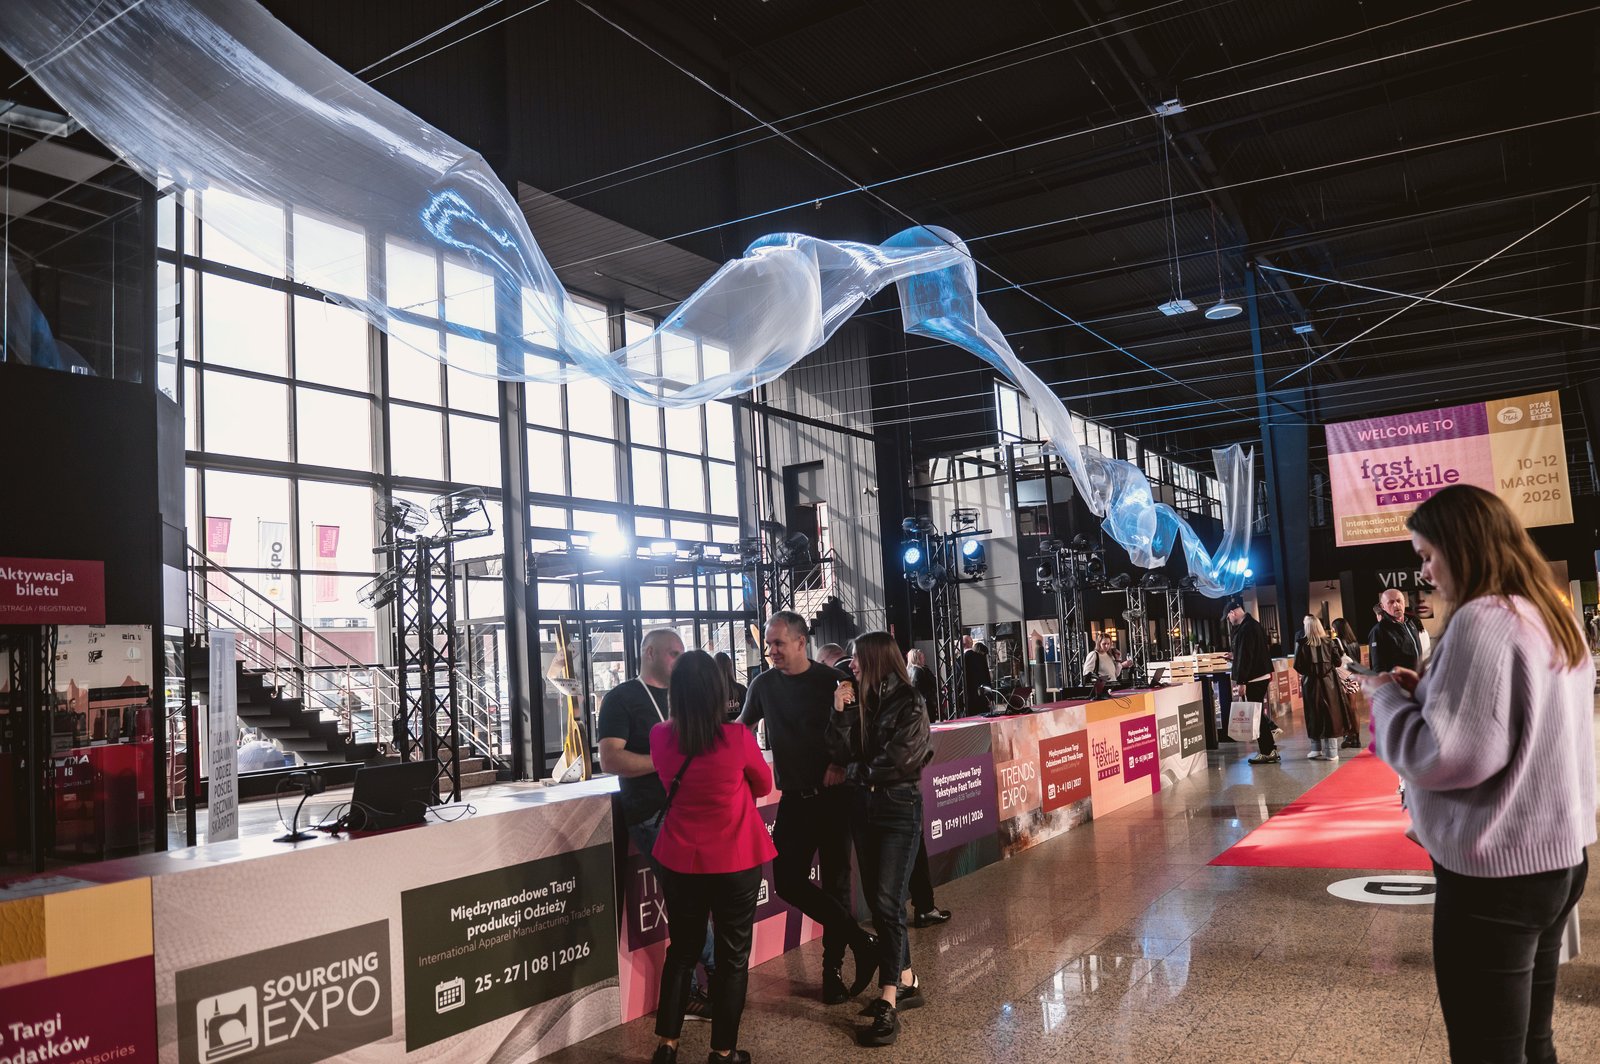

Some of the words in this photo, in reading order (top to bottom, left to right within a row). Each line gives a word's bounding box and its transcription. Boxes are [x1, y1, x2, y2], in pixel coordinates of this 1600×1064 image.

[1529, 401, 1551, 410] PTAK
[1530, 408, 1552, 416] EXPO
[1358, 422, 1430, 442] WELCOME
[1433, 419, 1454, 432] TO
[1361, 456, 1414, 479] fast
[1517, 455, 1557, 470] 10-12
[1372, 464, 1460, 491] textile
[1501, 472, 1559, 489] MARCH
[1380, 491, 1432, 503] FABRI
[1522, 489, 1561, 503] 2026
[1346, 515, 1398, 528] International
[1347, 527, 1382, 537] Knitwear
[1383, 525, 1400, 533] and
[0, 567, 74, 584] Aktywacja
[1379, 572, 1407, 588] VIP
[16, 583, 58, 597] biletu
[38, 605, 87, 613] REGISTRATION
[1092, 738, 1107, 757] fast
[1166, 731, 1178, 748] EXPO
[1096, 745, 1119, 768] textile
[932, 770, 971, 787] Międzynarodowe
[970, 766, 982, 777] Targi
[1001, 761, 1035, 788] TRENDS
[935, 785, 957, 798] Tekstylne
[958, 782, 967, 792] Fast
[967, 778, 982, 790] Textile
[1002, 784, 1027, 810] EXPO
[945, 817, 959, 831] 17-19
[971, 809, 984, 822] 2026
[450, 885, 548, 922] Międzynarodowe
[549, 876, 576, 895] Targi
[467, 911, 522, 941] produkcji
[524, 899, 567, 921] Odzieży
[639, 899, 668, 933] EX
[418, 941, 477, 967] International
[478, 930, 512, 950] Apparel
[513, 914, 570, 938] Manufacturing
[570, 907, 591, 921] Trade
[592, 903, 605, 914] Fair
[263, 951, 378, 1001] SOURCING
[475, 973, 492, 994] 25
[504, 964, 520, 984] 27
[531, 955, 548, 974] 08
[559, 941, 590, 965] 2026
[263, 975, 380, 1047] EXPO
[8, 1013, 62, 1042] Targi
